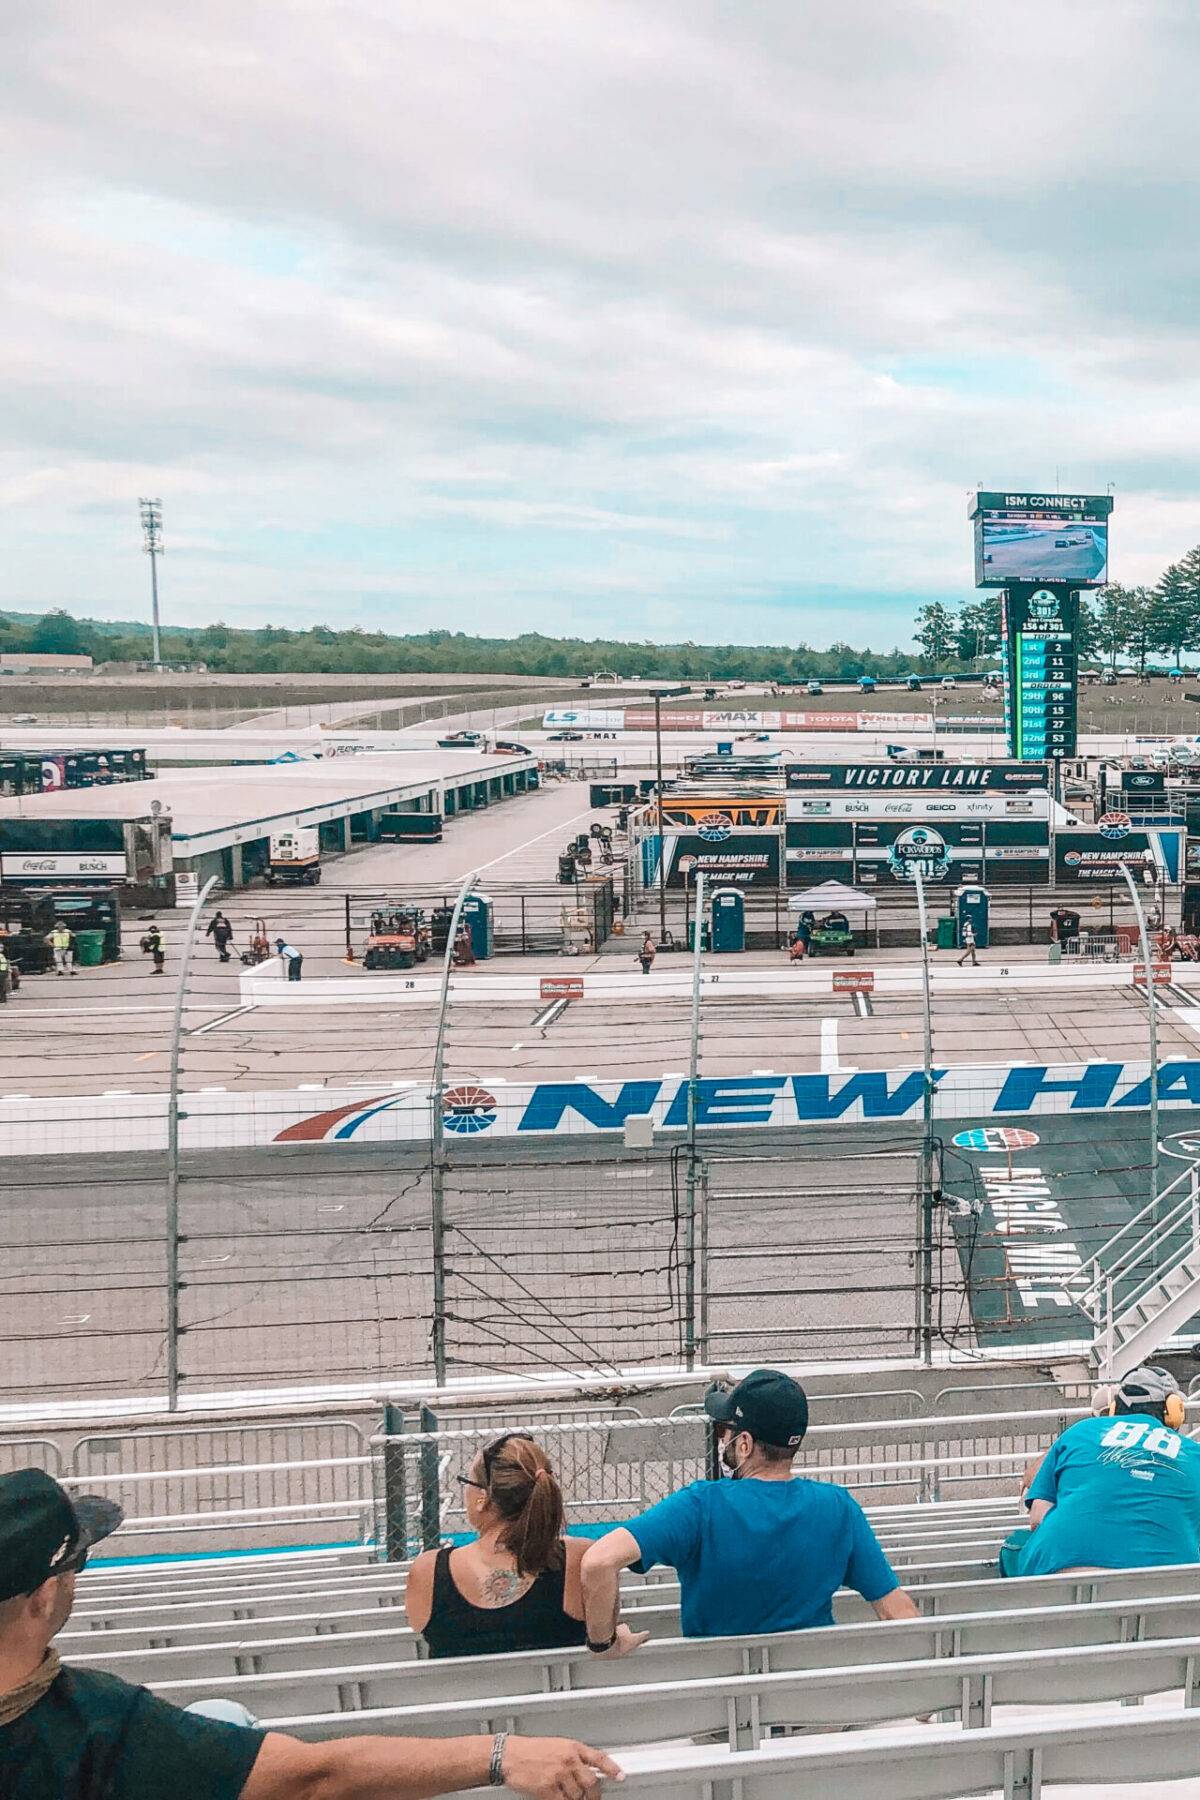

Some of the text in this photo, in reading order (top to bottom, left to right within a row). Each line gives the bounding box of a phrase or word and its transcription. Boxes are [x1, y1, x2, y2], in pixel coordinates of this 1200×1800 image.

[1005, 496, 1087, 508] ISM CONNECT
[1055, 644, 1062, 652] 2
[1024, 656, 1064, 666] 2nd 11
[1024, 670, 1064, 680] 3rd 22
[1023, 692, 1064, 701] 29th 96
[1052, 706, 1064, 715] 15
[545, 711, 578, 722] LS
[1052, 720, 1064, 729] 27
[1052, 734, 1064, 742] 53
[844, 769, 932, 785] VICTORY
[941, 769, 992, 785] LANE
[845, 803, 869, 812] BUSCH
[697, 854, 770, 864] NEW HAMPSHIRE
[1081, 851, 1099, 861] NEW
[79, 862, 108, 871] BUSCH
[999, 967, 1010, 977] 26
[710, 975, 720, 983] 27
[404, 980, 416, 989] 28
[517, 1069, 950, 1131] NEW
[979, 1167, 1102, 1308] MAGIC MILE
